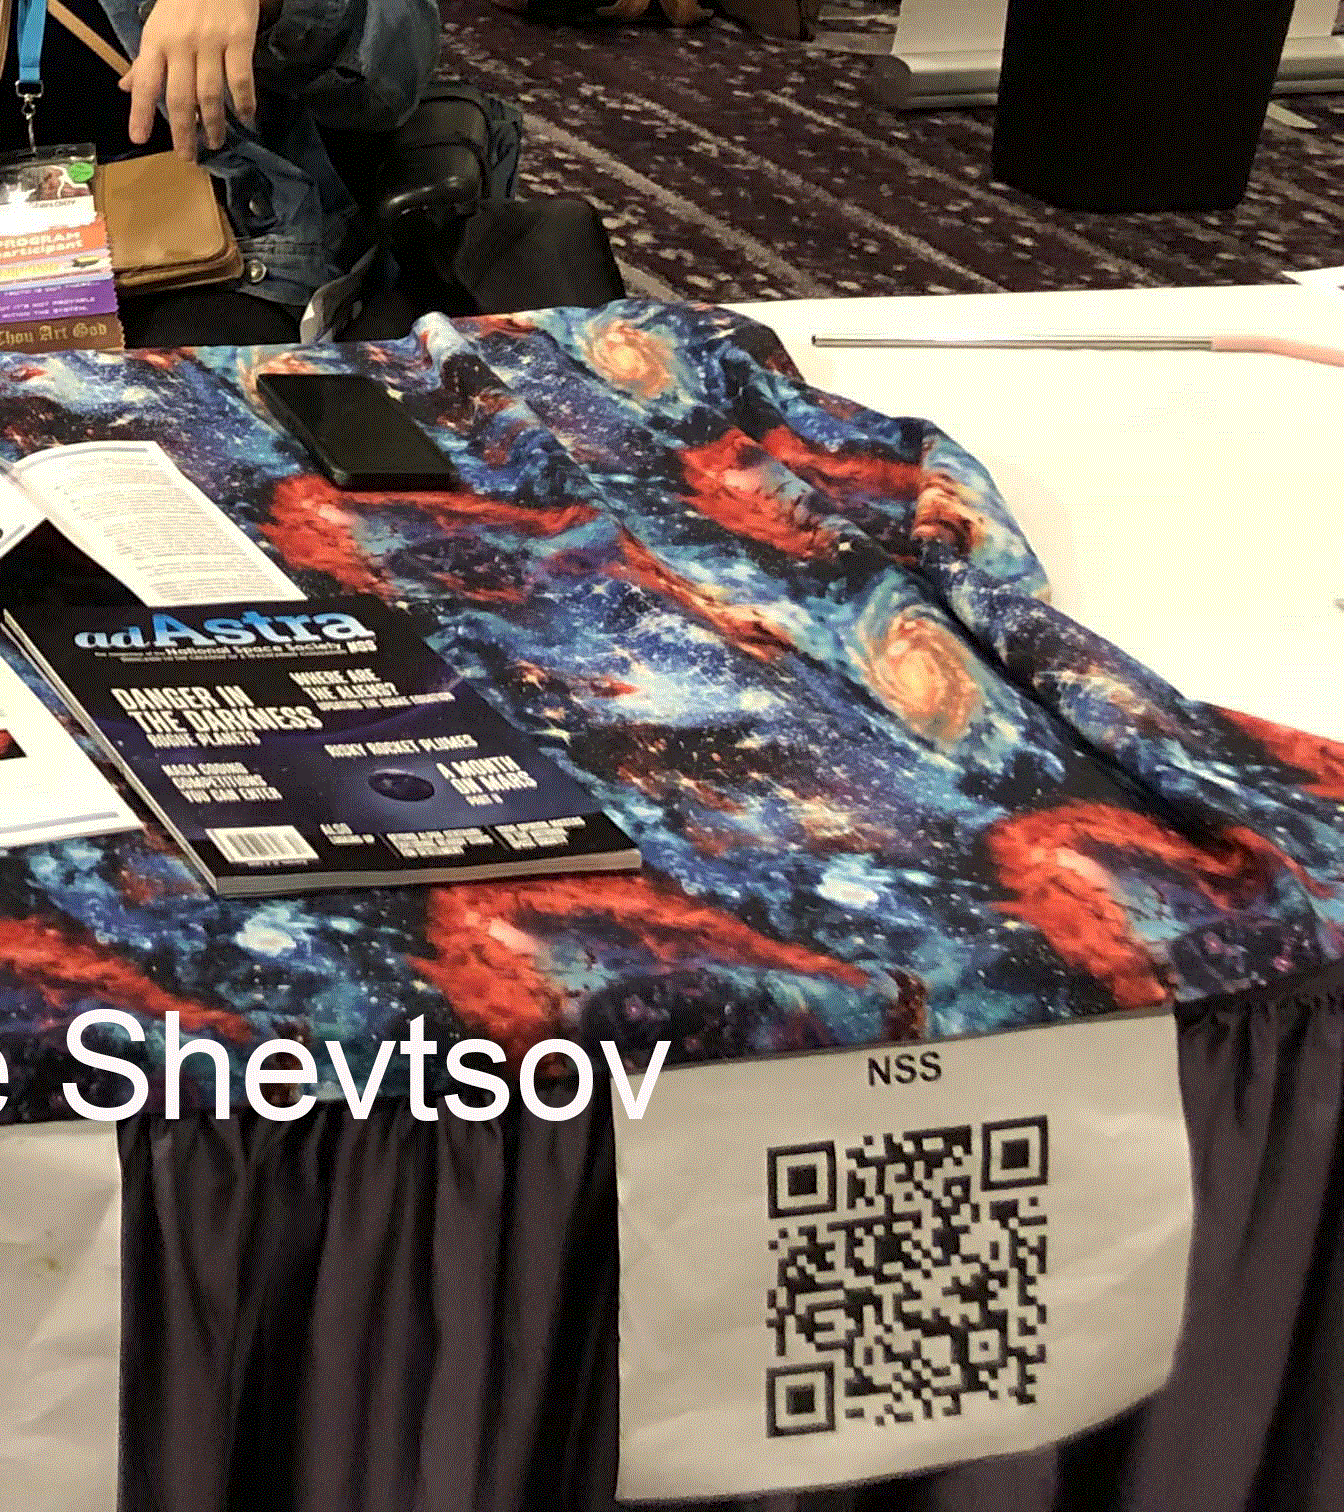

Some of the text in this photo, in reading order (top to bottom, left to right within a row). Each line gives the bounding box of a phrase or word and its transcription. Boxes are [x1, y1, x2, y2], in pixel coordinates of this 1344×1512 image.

[289, 670, 350, 687] WHERE
[111, 685, 255, 710] DANGER IN
[126, 705, 324, 734] THE DARKNESS
[865, 1053, 944, 1088] NSS
